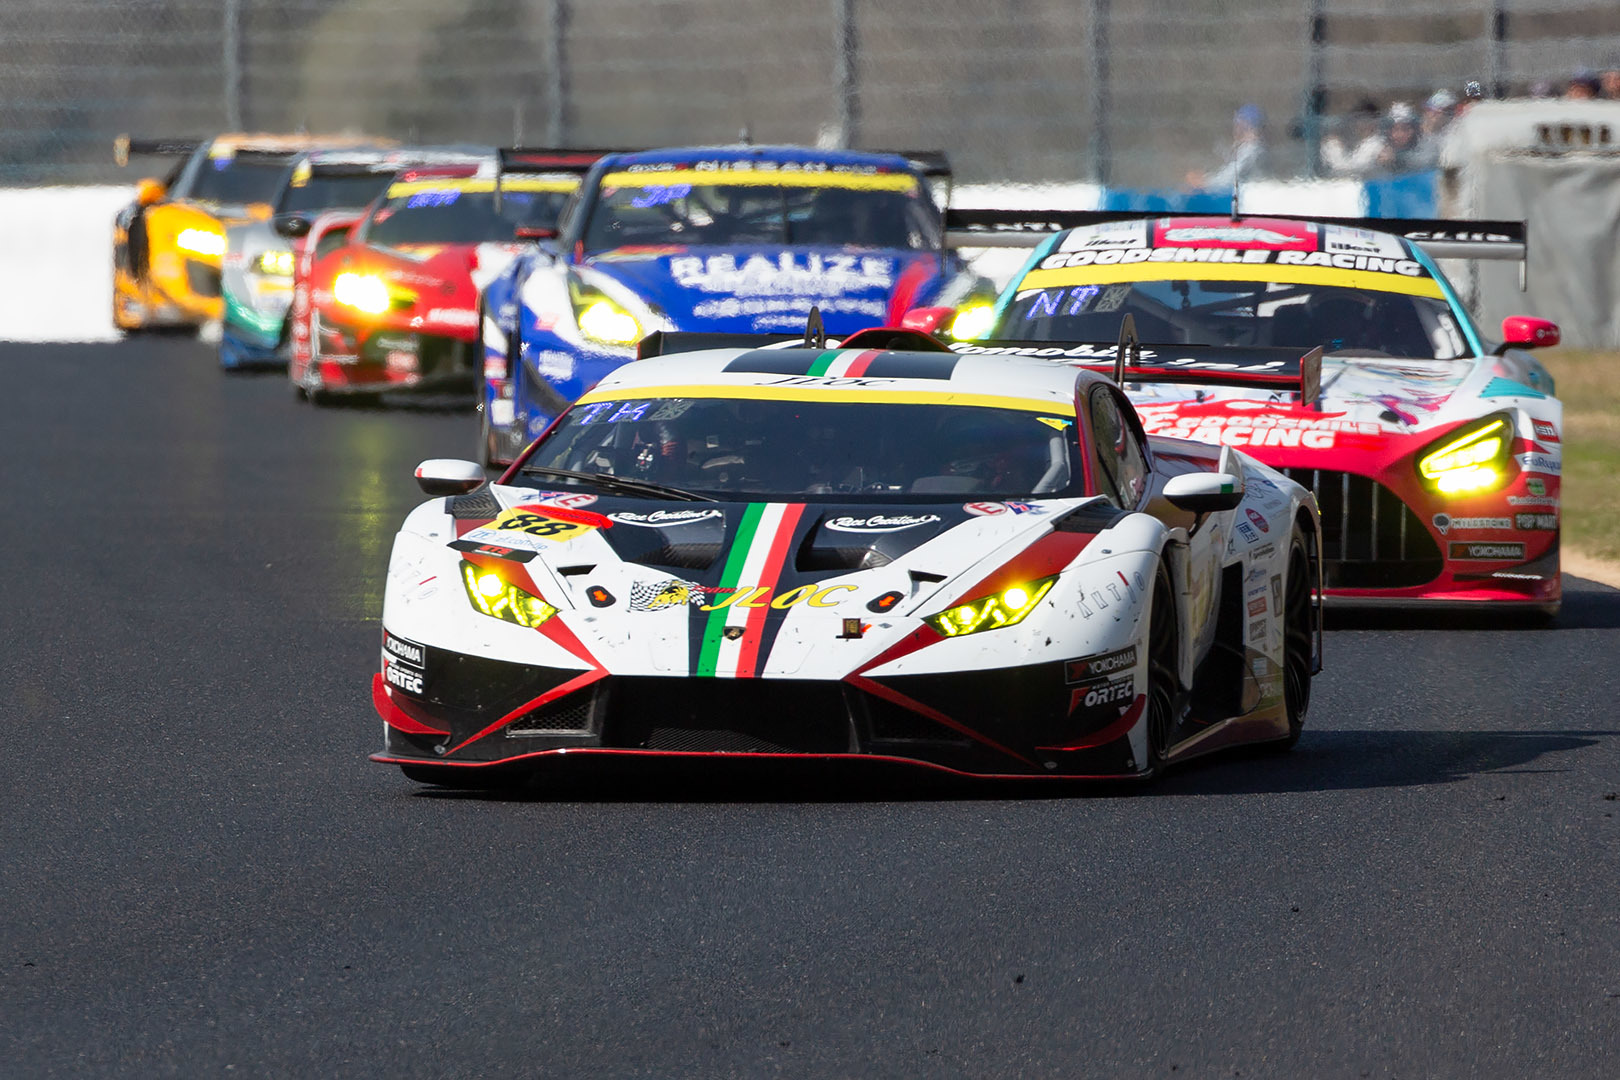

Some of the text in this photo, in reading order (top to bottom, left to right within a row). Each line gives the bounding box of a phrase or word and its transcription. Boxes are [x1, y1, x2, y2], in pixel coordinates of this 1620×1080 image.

[1041, 247, 1423, 276] GOODSMILE RACING
[1176, 415, 1382, 436] GOODSMILE
[498, 514, 579, 537] 88
[1469, 545, 1522, 556] YOKOHAMA
[700, 584, 859, 611] JLOC
[1089, 651, 1136, 674] YOKOHAMA
